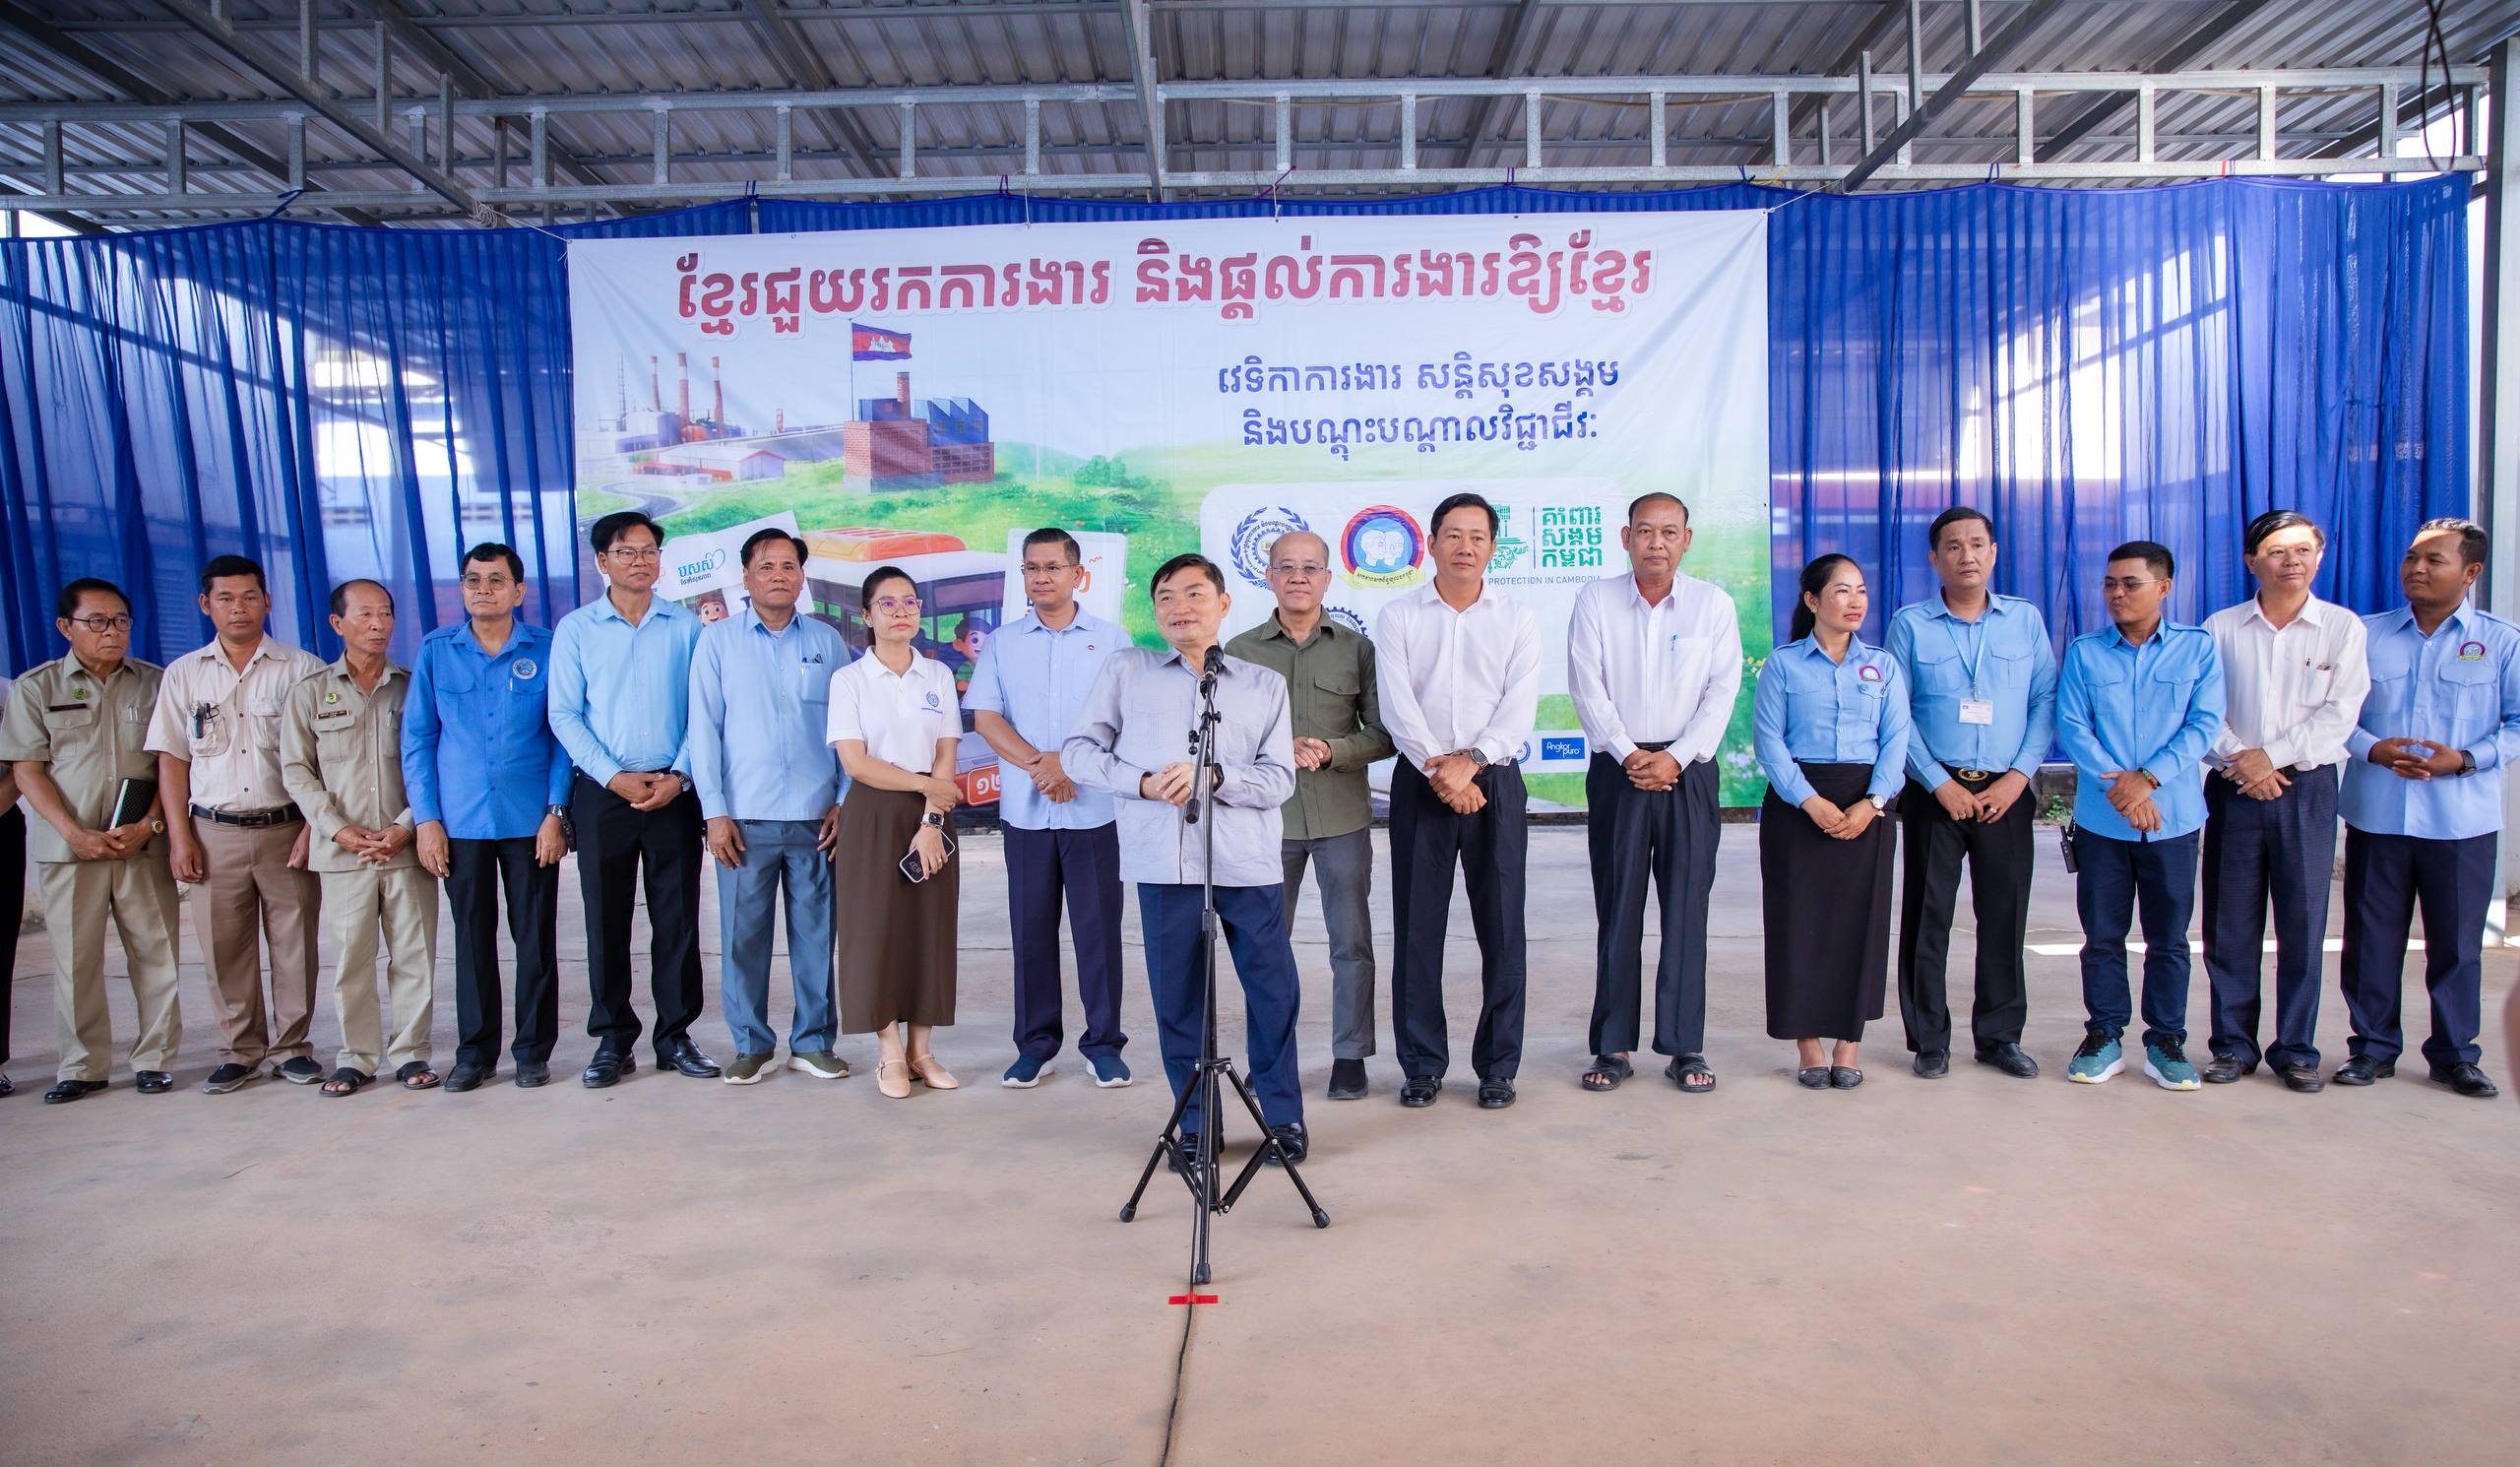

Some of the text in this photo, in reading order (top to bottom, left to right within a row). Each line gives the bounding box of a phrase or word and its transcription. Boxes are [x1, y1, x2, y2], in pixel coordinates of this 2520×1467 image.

[677, 253, 1110, 334] ខ្មែរជួយរកការងារ
[1219, 354, 1402, 394] វេទិកាការងារ
[1488, 575, 1543, 586] PROTECTION
[1546, 741, 1571, 753] Angkor
[1562, 748, 1580, 757] puro
